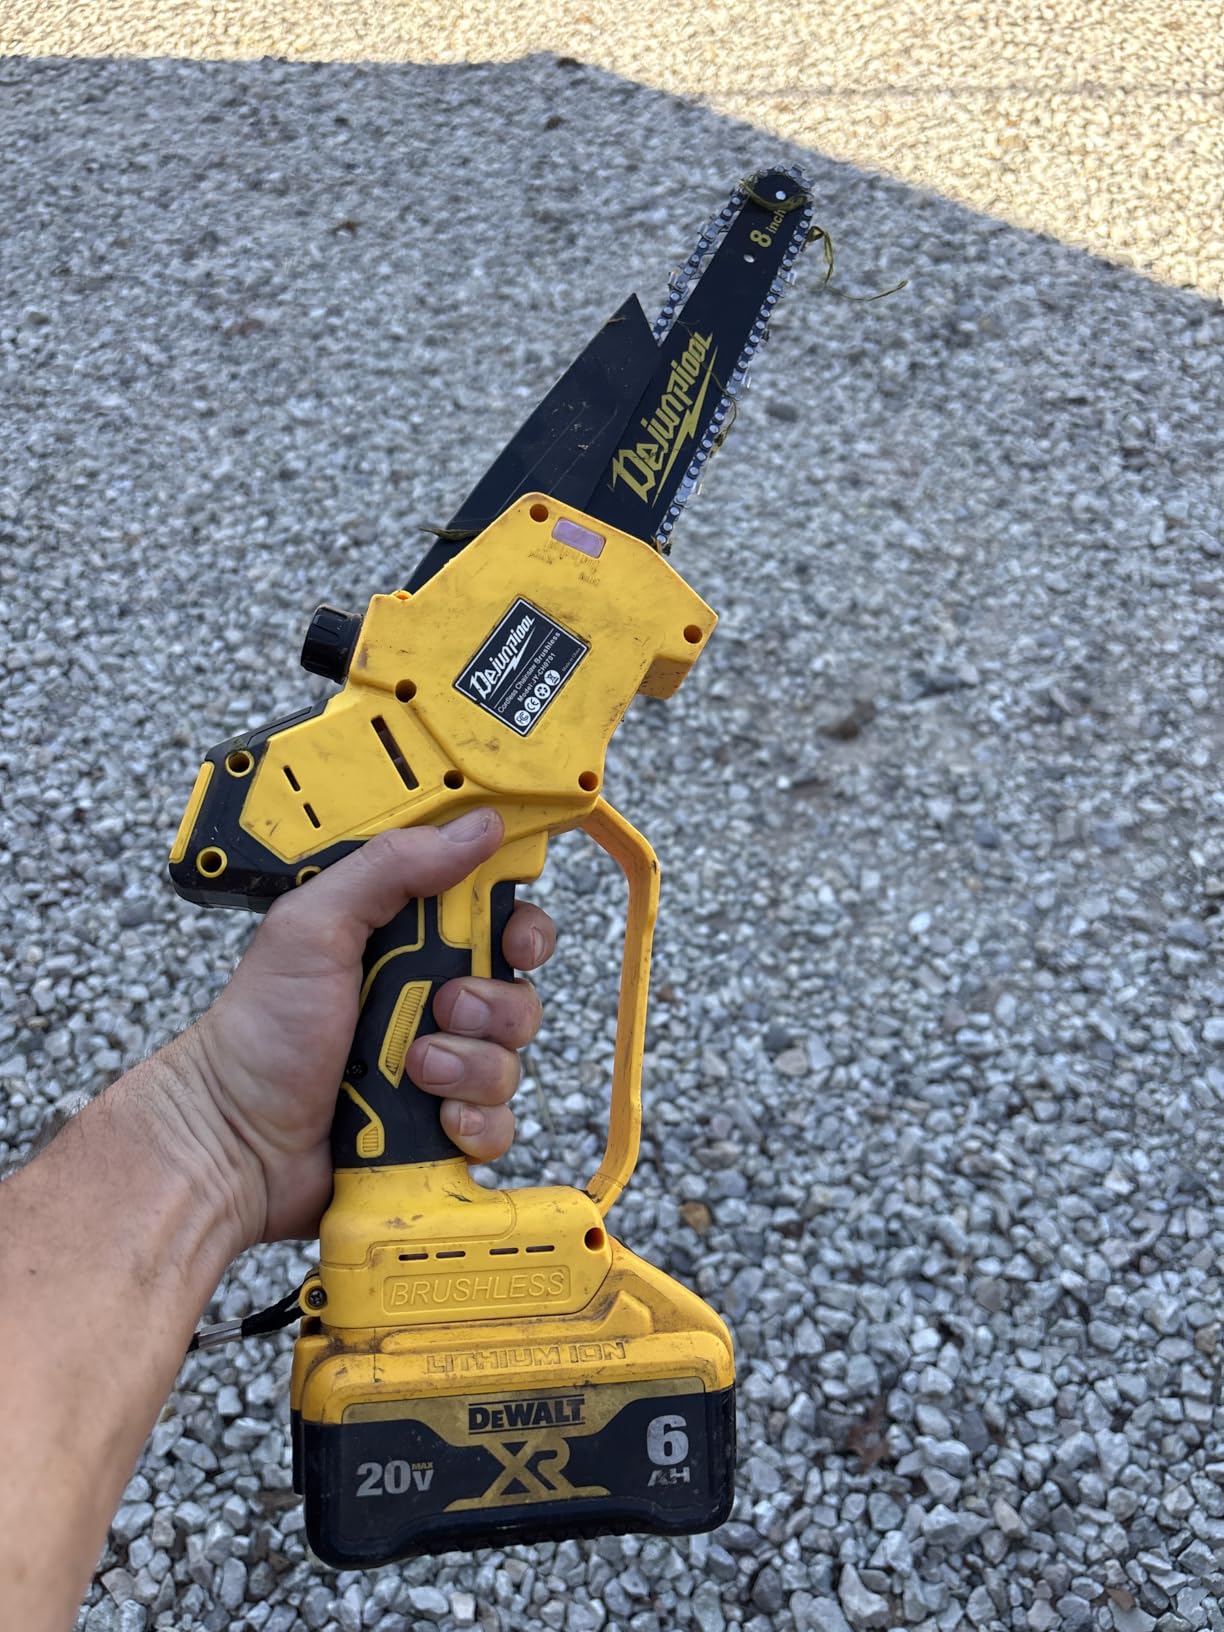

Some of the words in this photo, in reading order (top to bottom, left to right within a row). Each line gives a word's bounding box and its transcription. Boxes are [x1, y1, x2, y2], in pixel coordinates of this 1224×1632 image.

[750, 230, 772, 247] 8
[766, 209, 787, 234] inch
[497, 689, 518, 713] Cordless
[515, 663, 537, 690] Chainsaw
[533, 632, 561, 664] Brushless
[390, 1272, 564, 1305] BRUSHLESS
[426, 1346, 561, 1374] LITHIUM
[570, 1341, 626, 1363] ION
[647, 1414, 689, 1466] 6
[411, 1462, 434, 1471] MAX
[442, 1437, 612, 1513] XR
